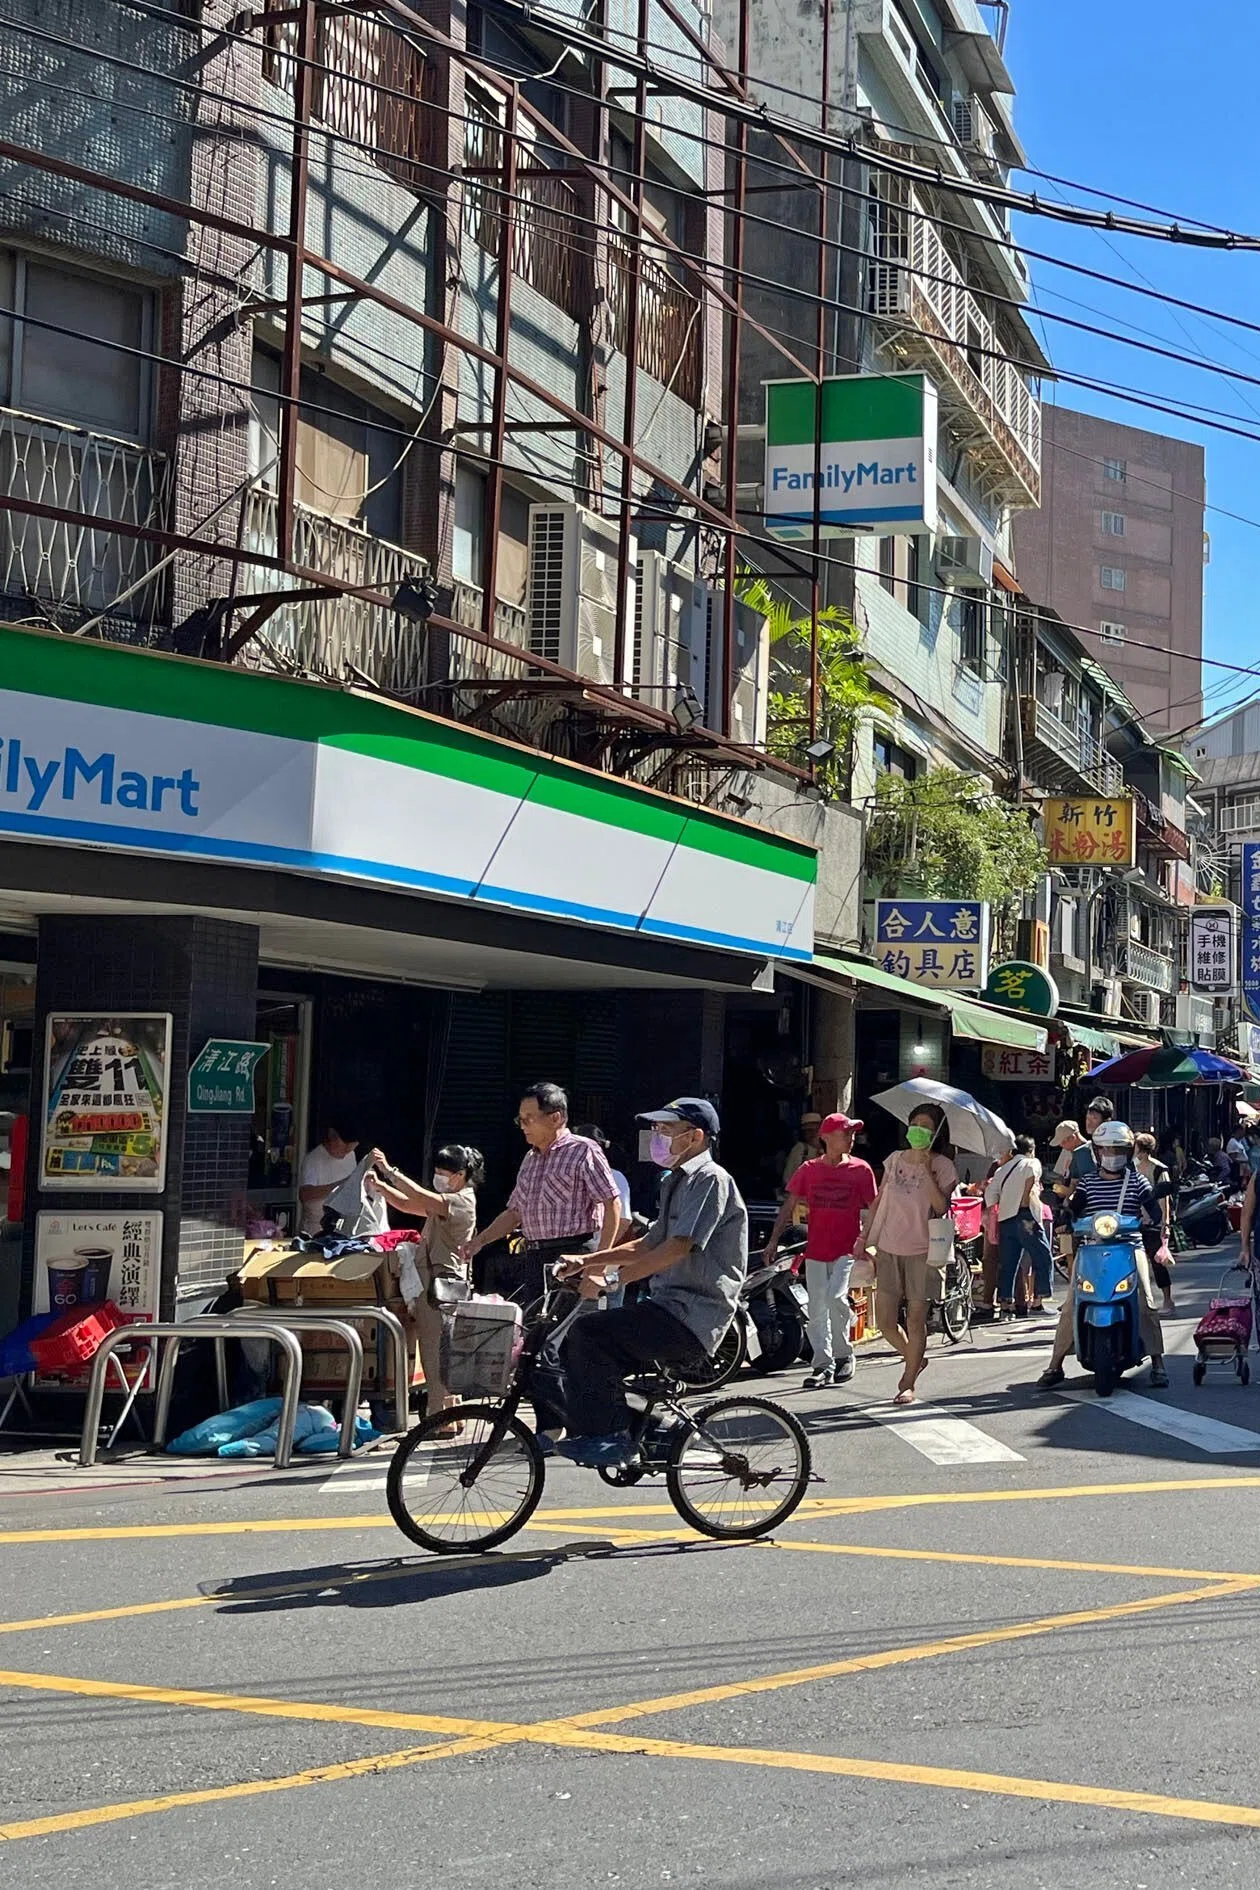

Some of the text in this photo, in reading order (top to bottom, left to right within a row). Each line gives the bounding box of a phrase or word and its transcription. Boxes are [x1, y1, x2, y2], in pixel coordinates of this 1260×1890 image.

[773, 462, 917, 493] FamilyMart
[1057, 802, 1118, 827] 新竹
[1050, 827, 1127, 861] 米粉湯
[880, 907, 978, 940] 合人意
[1197, 934, 1226, 948] 手機
[879, 948, 976, 980] 釣具店
[1197, 951, 1226, 965] 維修
[1197, 968, 1226, 982] 貼膜
[197, 1048, 256, 1082] 清江路
[999, 1050, 1051, 1076] 紅茶
[119, 1220, 142, 1307] 經典演繹
